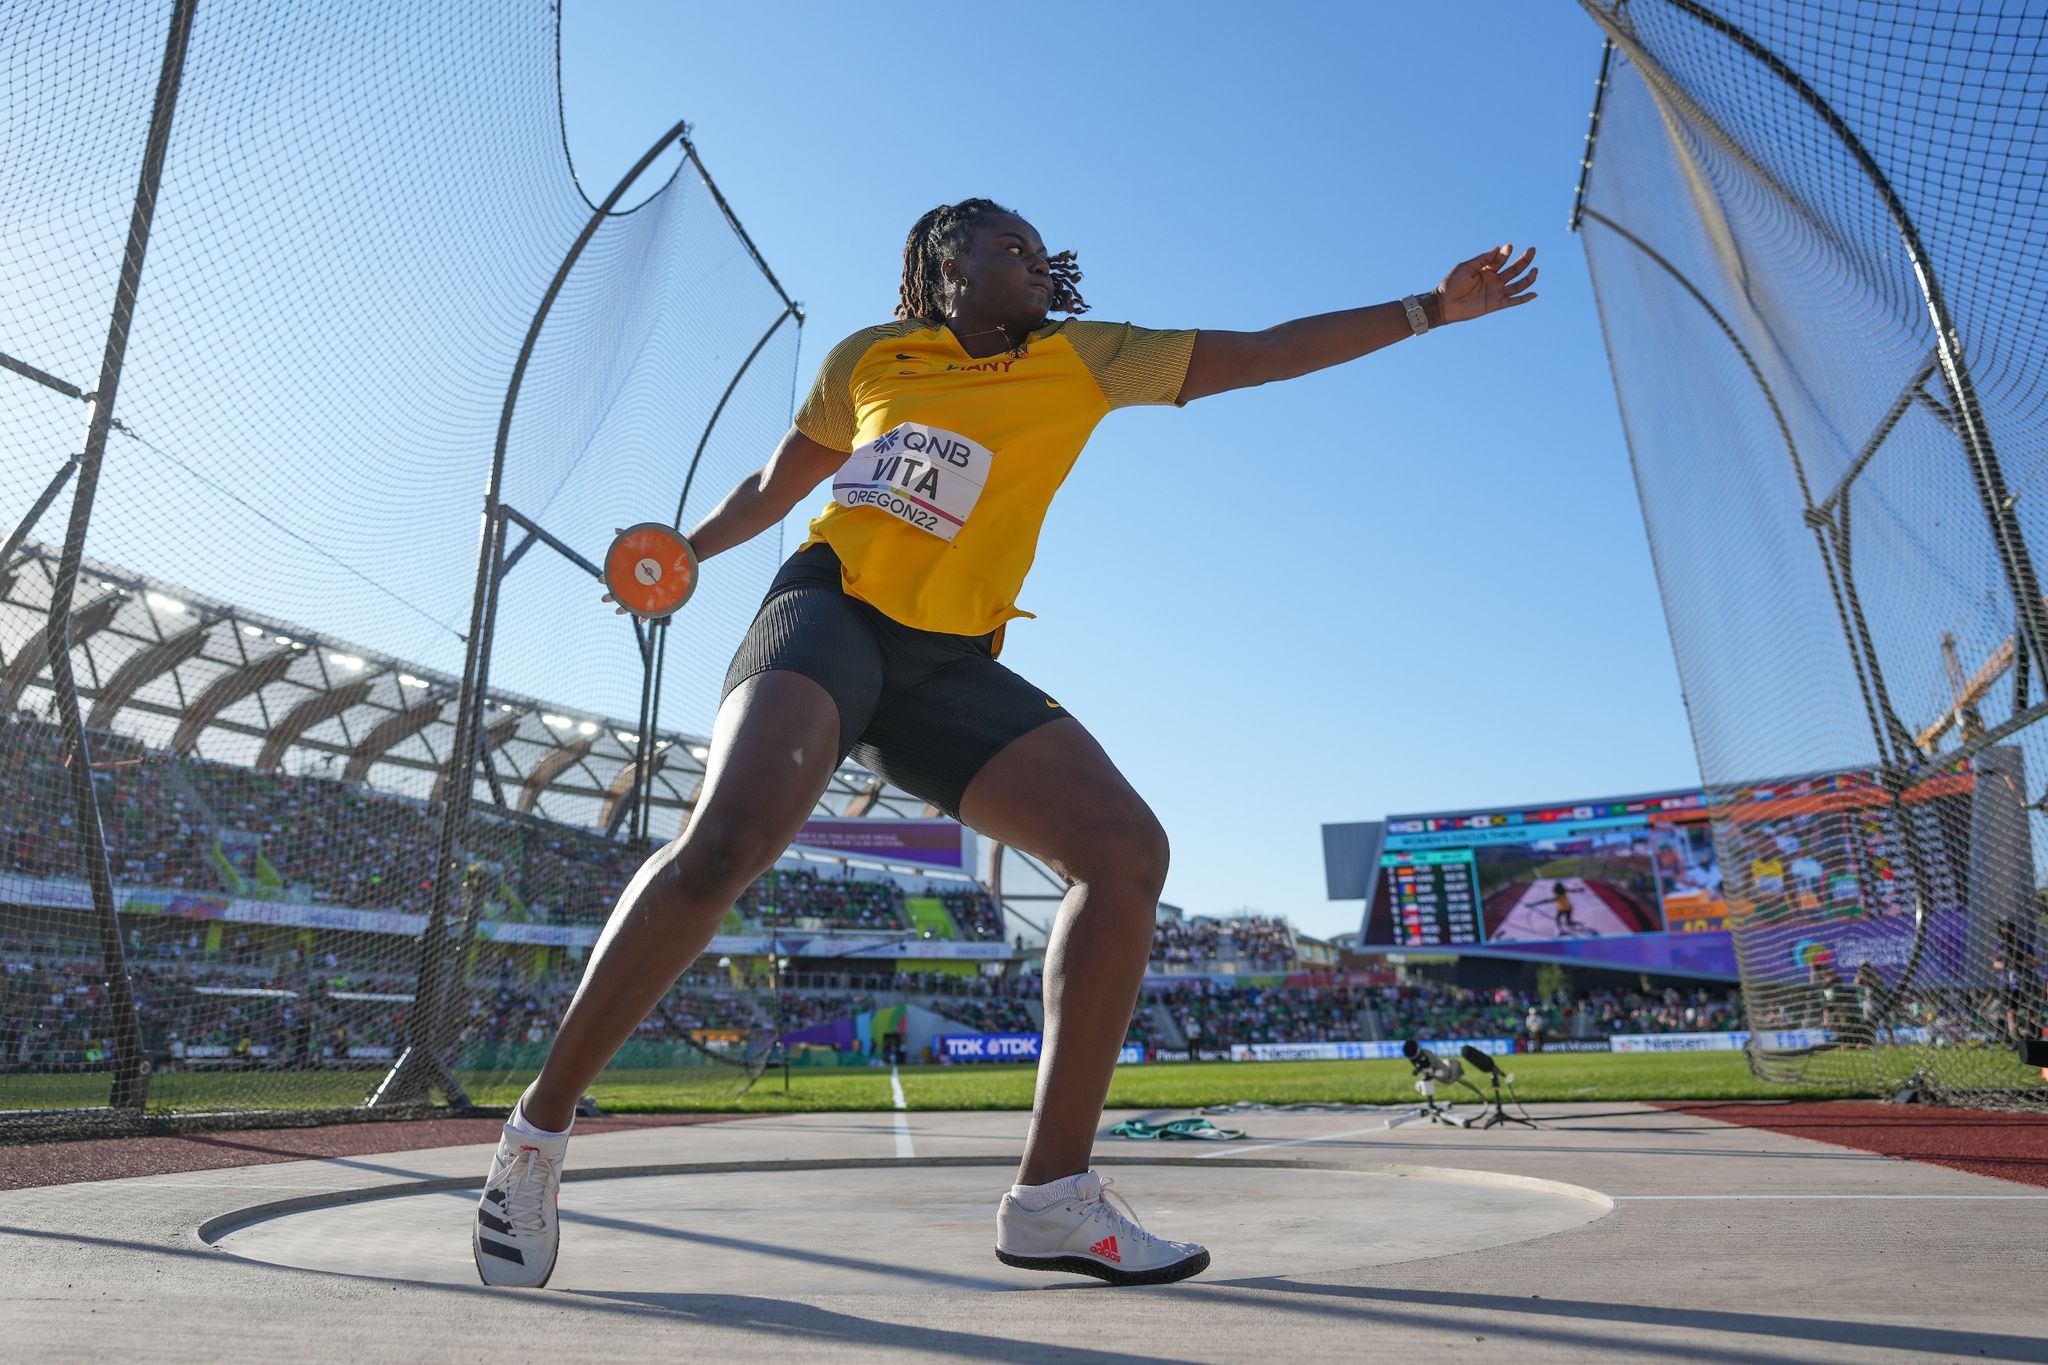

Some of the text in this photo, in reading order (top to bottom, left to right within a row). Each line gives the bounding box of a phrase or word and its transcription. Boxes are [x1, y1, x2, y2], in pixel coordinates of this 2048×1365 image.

[903, 431, 971, 468] QNB
[872, 456, 939, 501] VITA
[847, 490, 938, 531] OREGON22
[946, 1038, 984, 1055] TDK
[999, 1037, 1038, 1055] TDK
[1090, 1246, 1121, 1263] adidas
